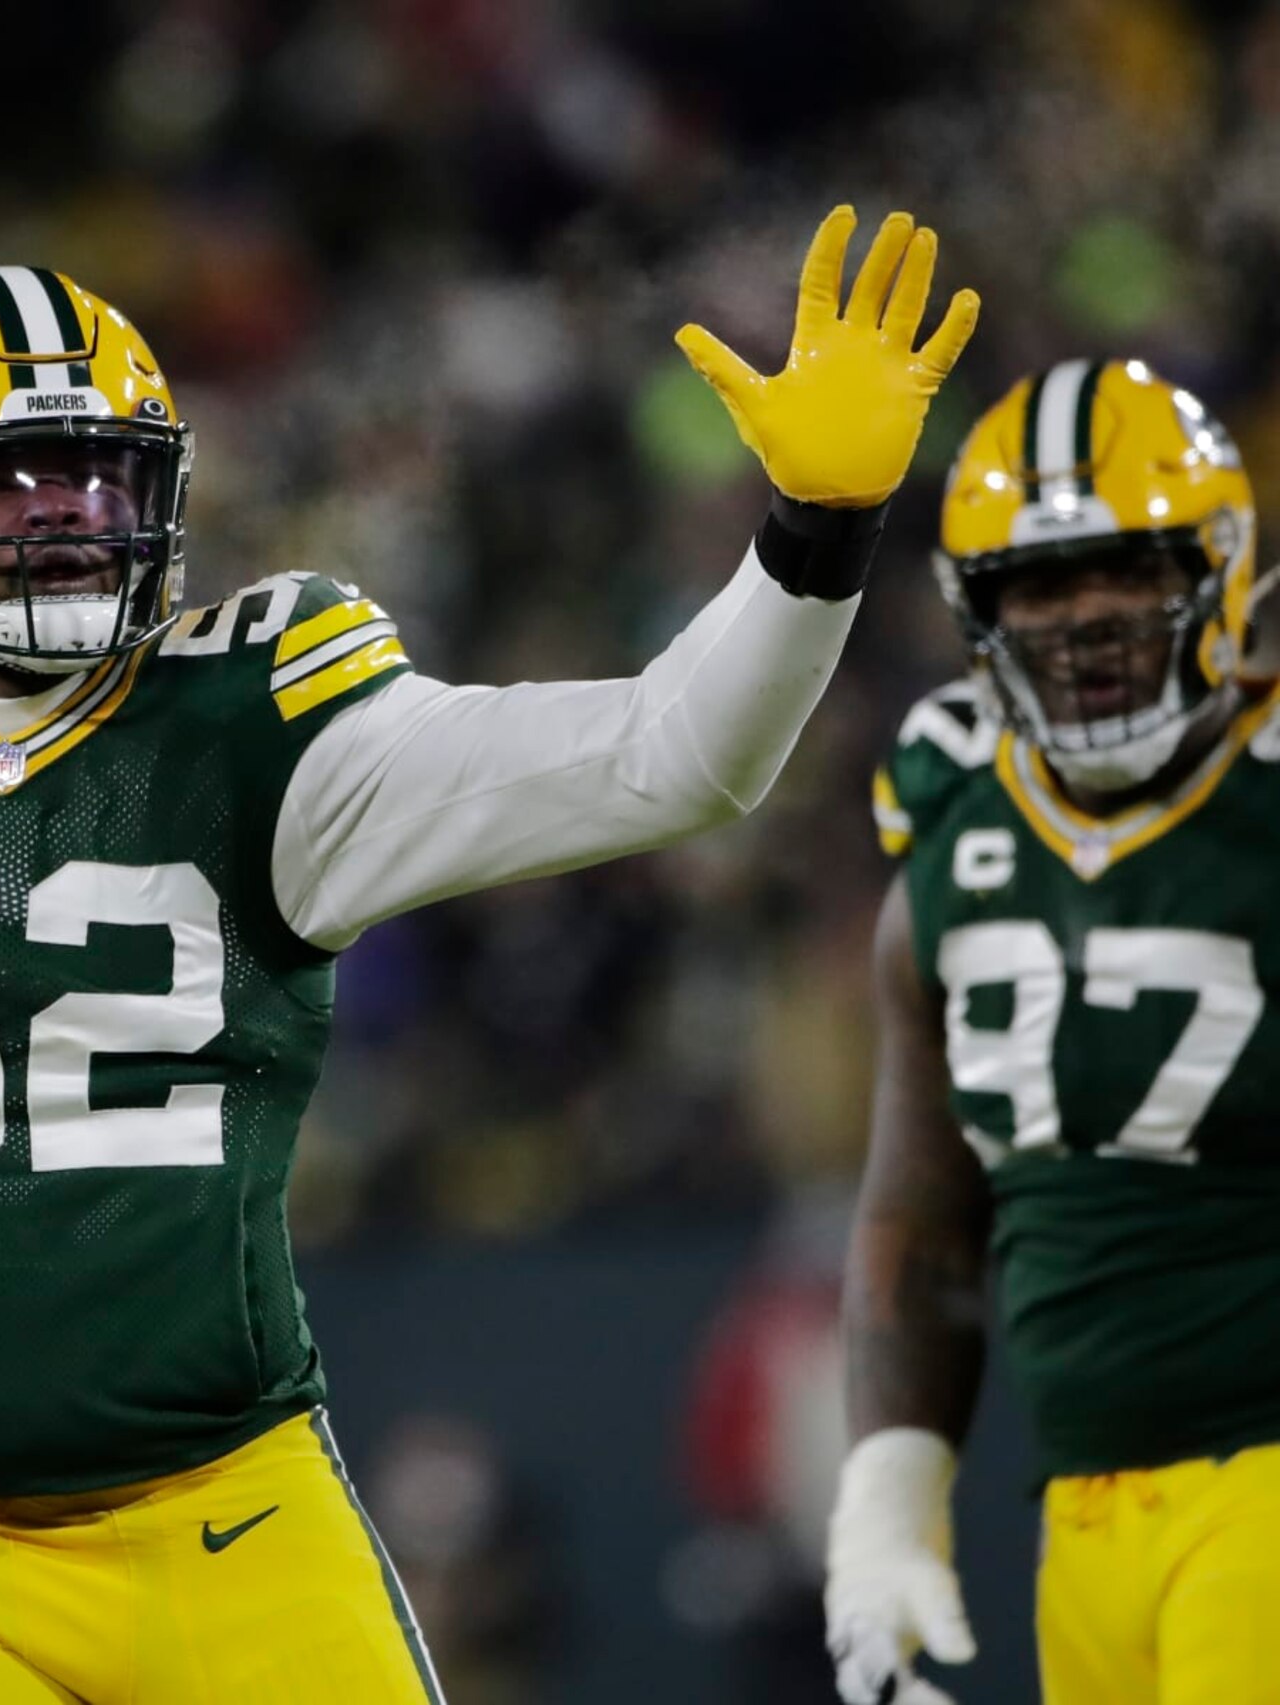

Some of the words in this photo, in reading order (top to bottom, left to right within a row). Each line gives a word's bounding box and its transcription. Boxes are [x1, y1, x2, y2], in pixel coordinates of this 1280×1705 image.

[26, 394, 88, 412] PACKERS
[953, 828, 1016, 890] C
[937, 919, 1266, 1168] 97
